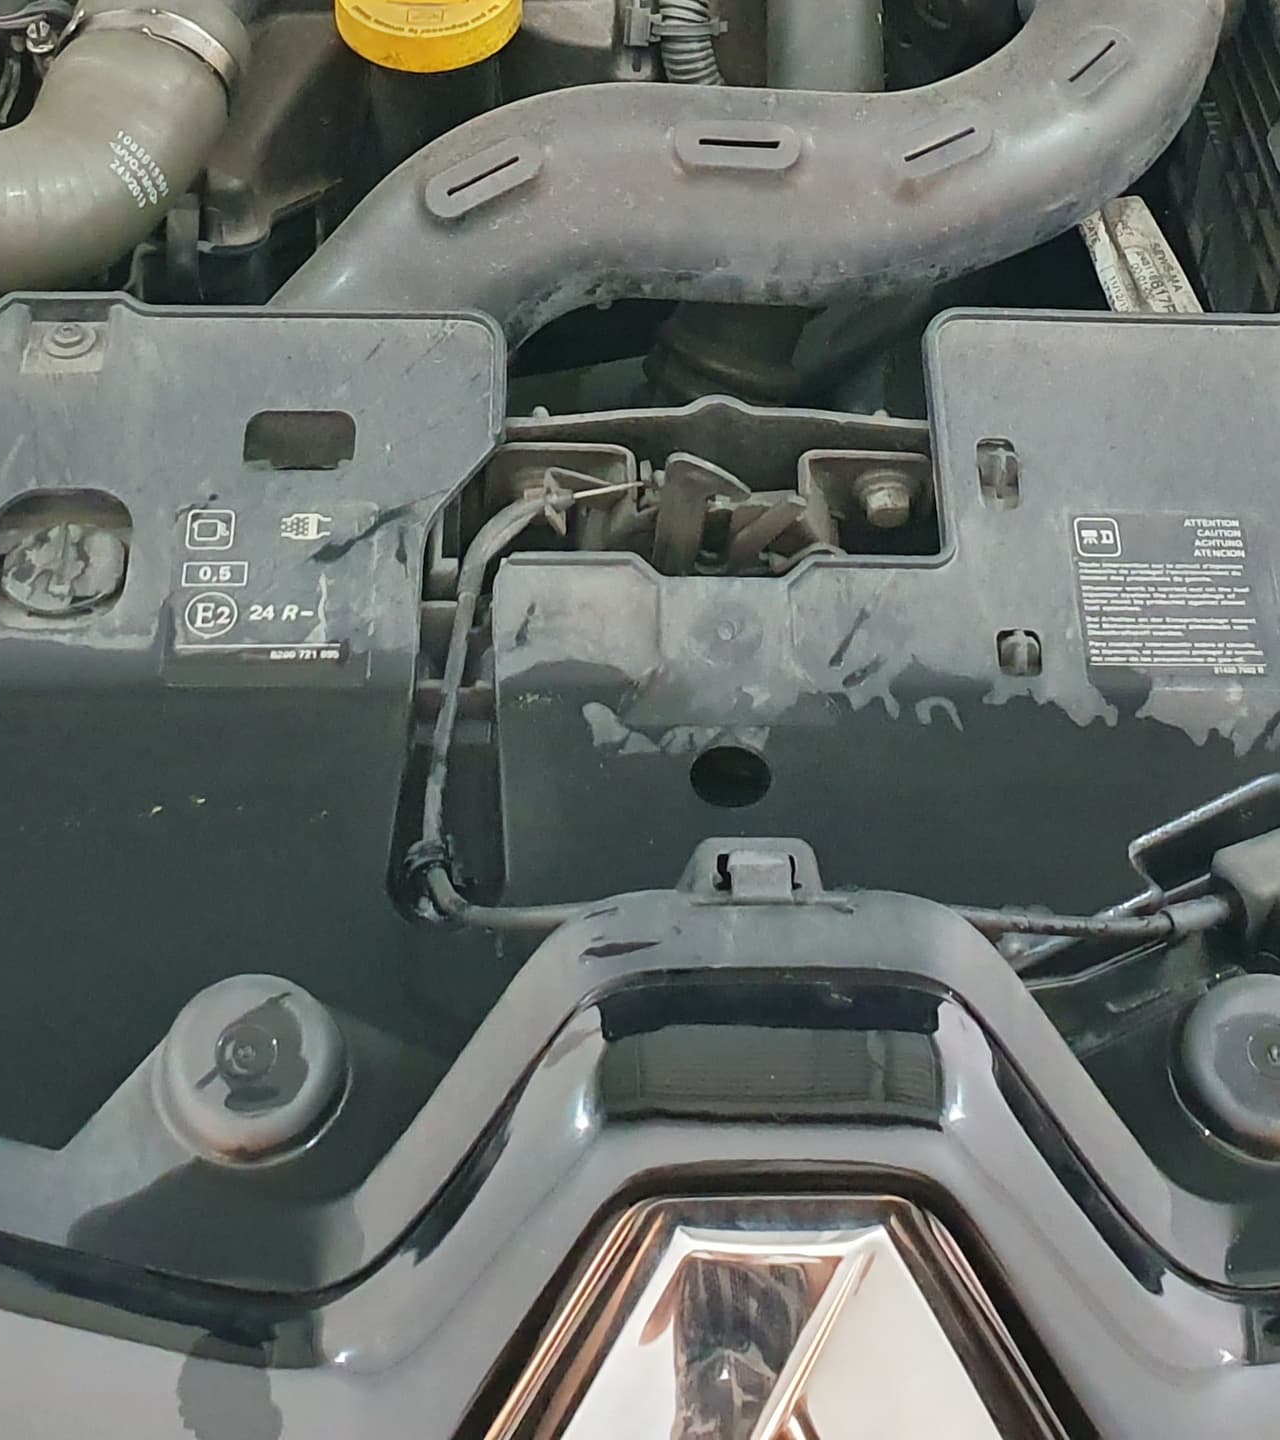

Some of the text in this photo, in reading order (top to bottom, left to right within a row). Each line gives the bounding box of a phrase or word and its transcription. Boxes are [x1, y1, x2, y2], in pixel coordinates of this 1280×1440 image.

[1183, 518, 1240, 528] ATTENTION
[1196, 528, 1241, 538] CAUTION
[1194, 539, 1243, 548] ACHTUNG
[198, 565, 232, 583] 0,5
[193, 602, 232, 629] E2
[248, 606, 275, 621] 24
